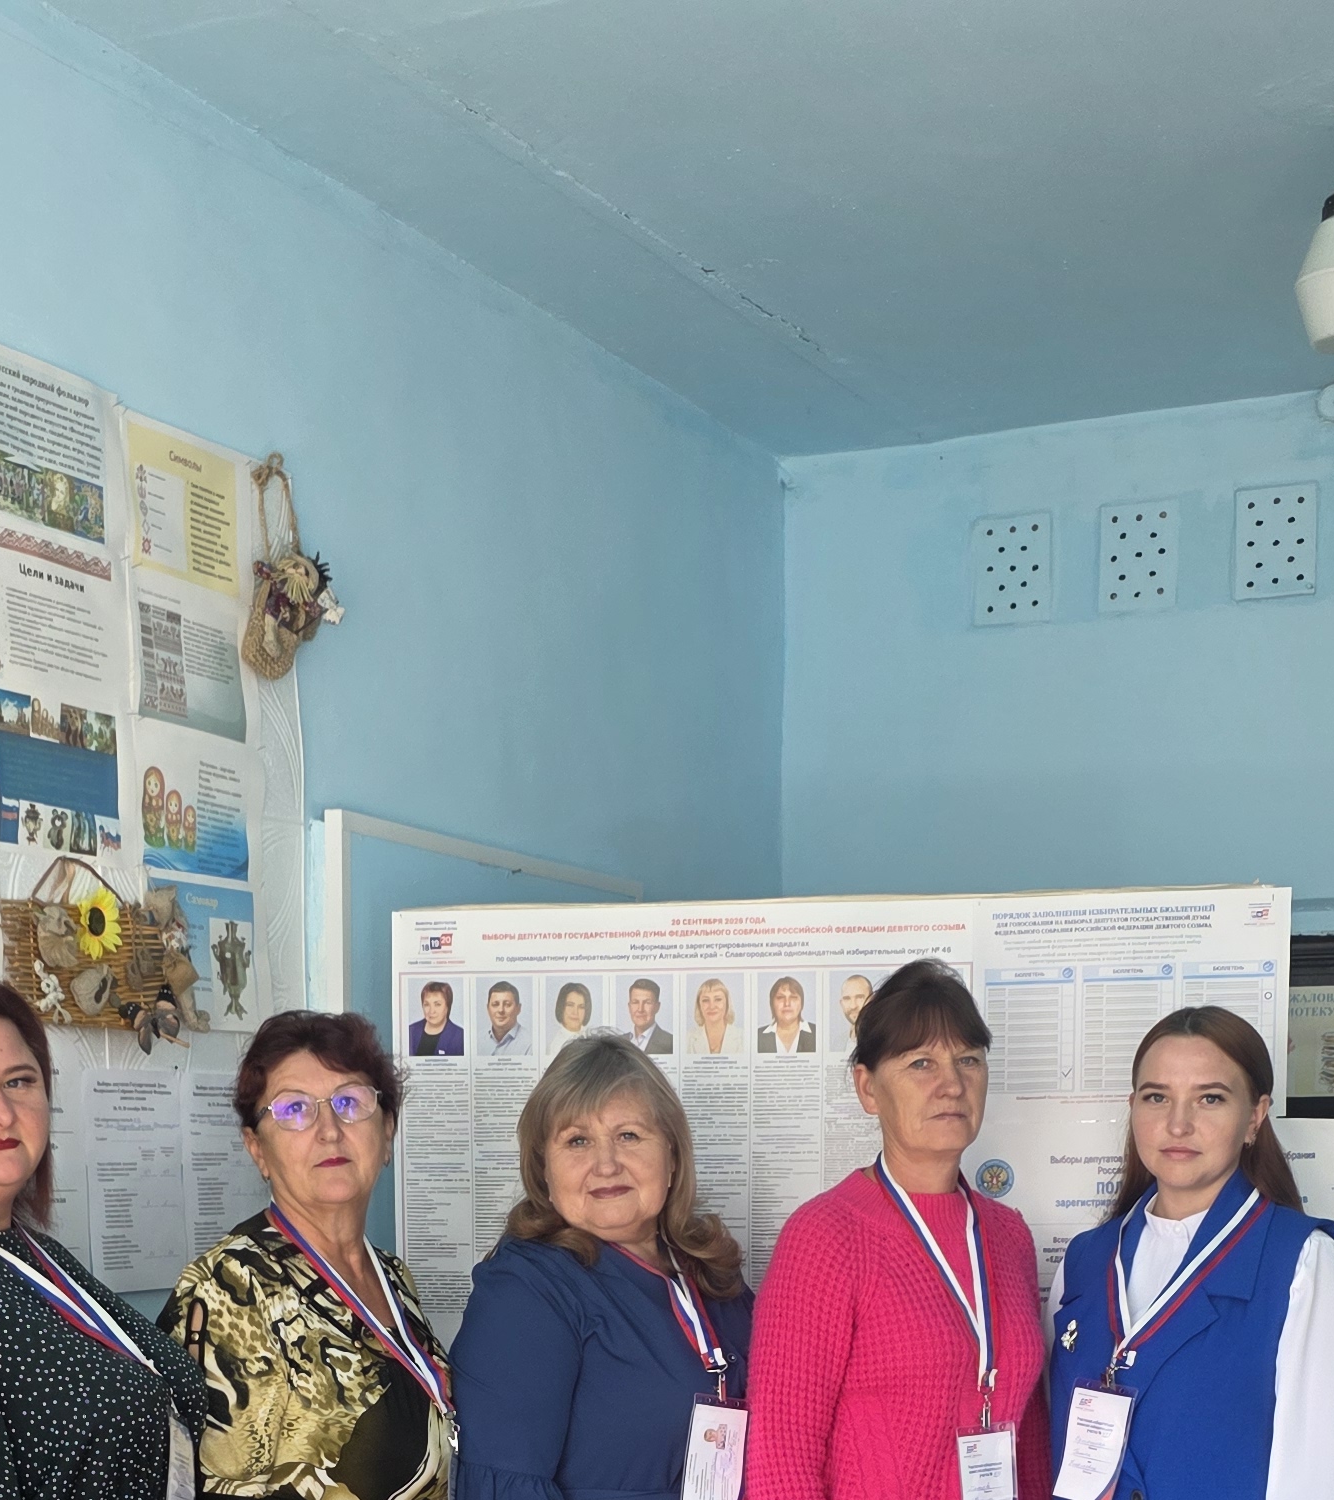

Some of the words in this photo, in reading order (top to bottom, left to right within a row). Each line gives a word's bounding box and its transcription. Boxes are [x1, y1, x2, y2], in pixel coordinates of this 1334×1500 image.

[22, 373, 55, 394] народный
[56, 385, 90, 408] фольклор
[19, 562, 44, 580] Цели
[47, 573, 53, 583] и
[55, 575, 85, 593] задачи
[671, 918, 681, 926] 20
[682, 918, 723, 926] СЕНТЯБРЯ
[745, 916, 766, 925] ГОДА
[992, 912, 1031, 921] ПОРЯДОК
[1032, 909, 1087, 919] ЗАПОЛНЕНИЯ
[1088, 905, 1158, 916] ИЗБИРАТЕЛЬНЫХ
[1159, 904, 1215, 914] БЮЛЛЕТЕНЕЙ
[482, 933, 516, 941] ВЫБОРЫ
[517, 932, 563, 941] ДЕПУТАТОВ
[564, 930, 641, 940] ГОСУДАРСТВЕННОЙ
[642, 930, 667, 940] ДУМЫ
[668, 928, 731, 938] ФЕДЕРАЛЬНОГО
[733, 927, 776, 936] СОБРАНИЯ
[777, 925, 834, 935] РОССИЙСКОЙ
[834, 925, 886, 934] ФЕДЕРАЦИИ
[887, 924, 930, 933] ДЕВЯТОГО
[931, 923, 966, 931] СОЗЫВА
[421, 943, 430, 952] 18
[430, 939, 441, 949] 19
[440, 935, 452, 945] 20
[630, 943, 677, 953] Информация
[685, 941, 764, 951] зарегистрированных
[765, 940, 809, 949] кандидатах
[506, 954, 569, 964] одномандатному
[570, 953, 630, 963] избирательному
[632, 953, 658, 962] округу
[658, 950, 698, 961] Алтайский
[700, 951, 718, 960] край
[783, 948, 845, 958] одномандатный
[846, 947, 906, 957] избирательный
[907, 947, 929, 956] округ
[1050, 1155, 1082, 1165] Выборы
[1084, 1155, 1123, 1166] депутатов
[1096, 1181, 1123, 1195] ПОЛ
[1055, 1199, 1117, 1209] зарегистриро
